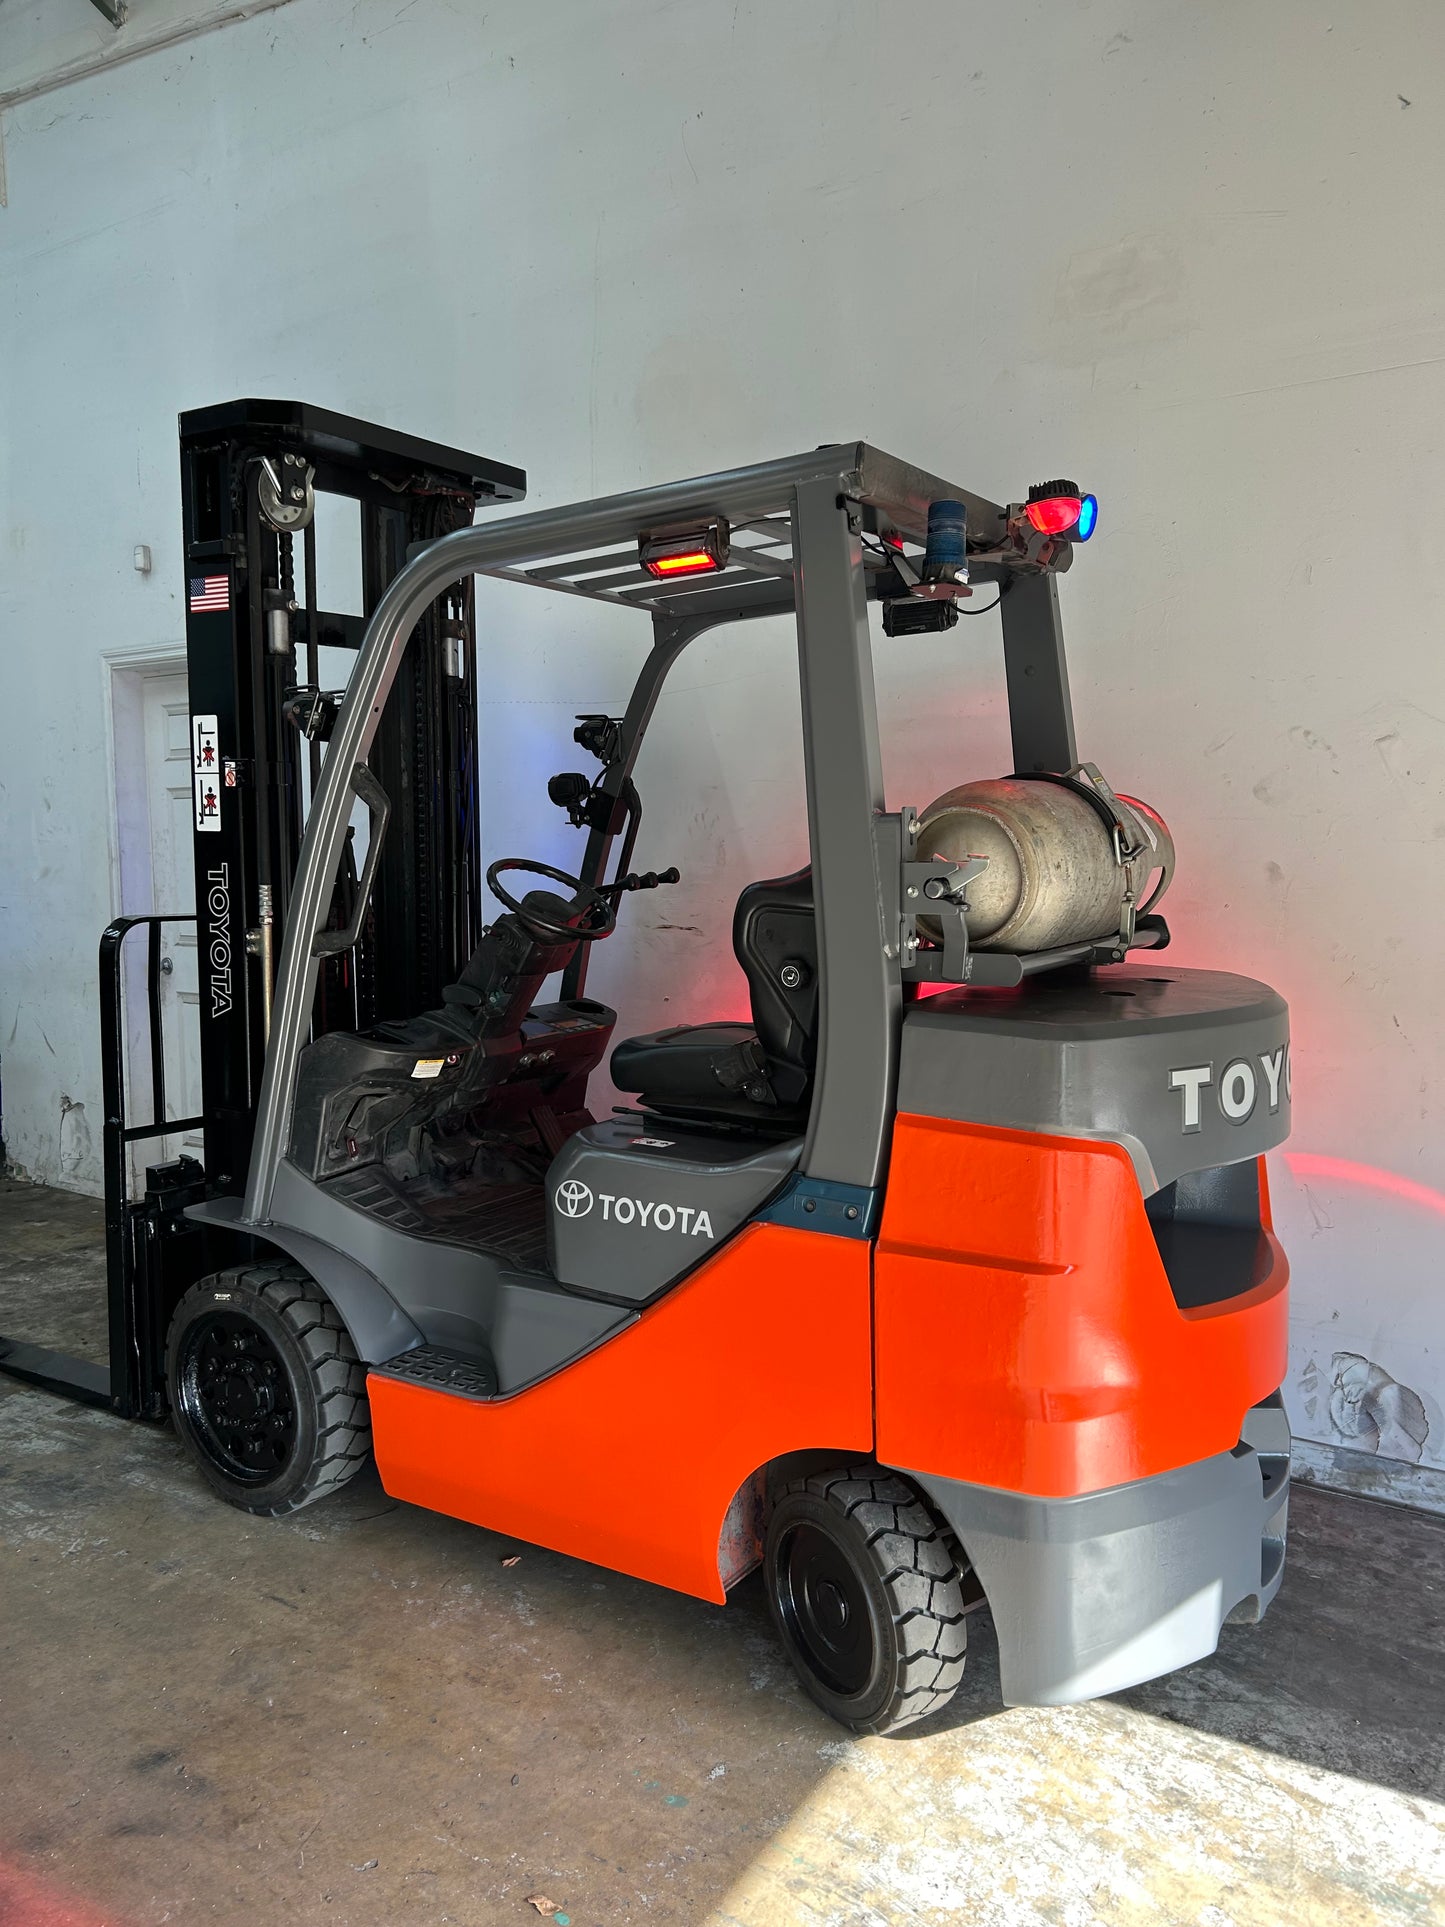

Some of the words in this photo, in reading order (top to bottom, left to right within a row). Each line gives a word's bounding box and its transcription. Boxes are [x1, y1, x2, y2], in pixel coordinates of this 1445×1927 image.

[208, 862, 232, 1018] TOYOTA
[1170, 1045, 1291, 1129] TOY
[598, 1193, 715, 1239] TOYOTA
